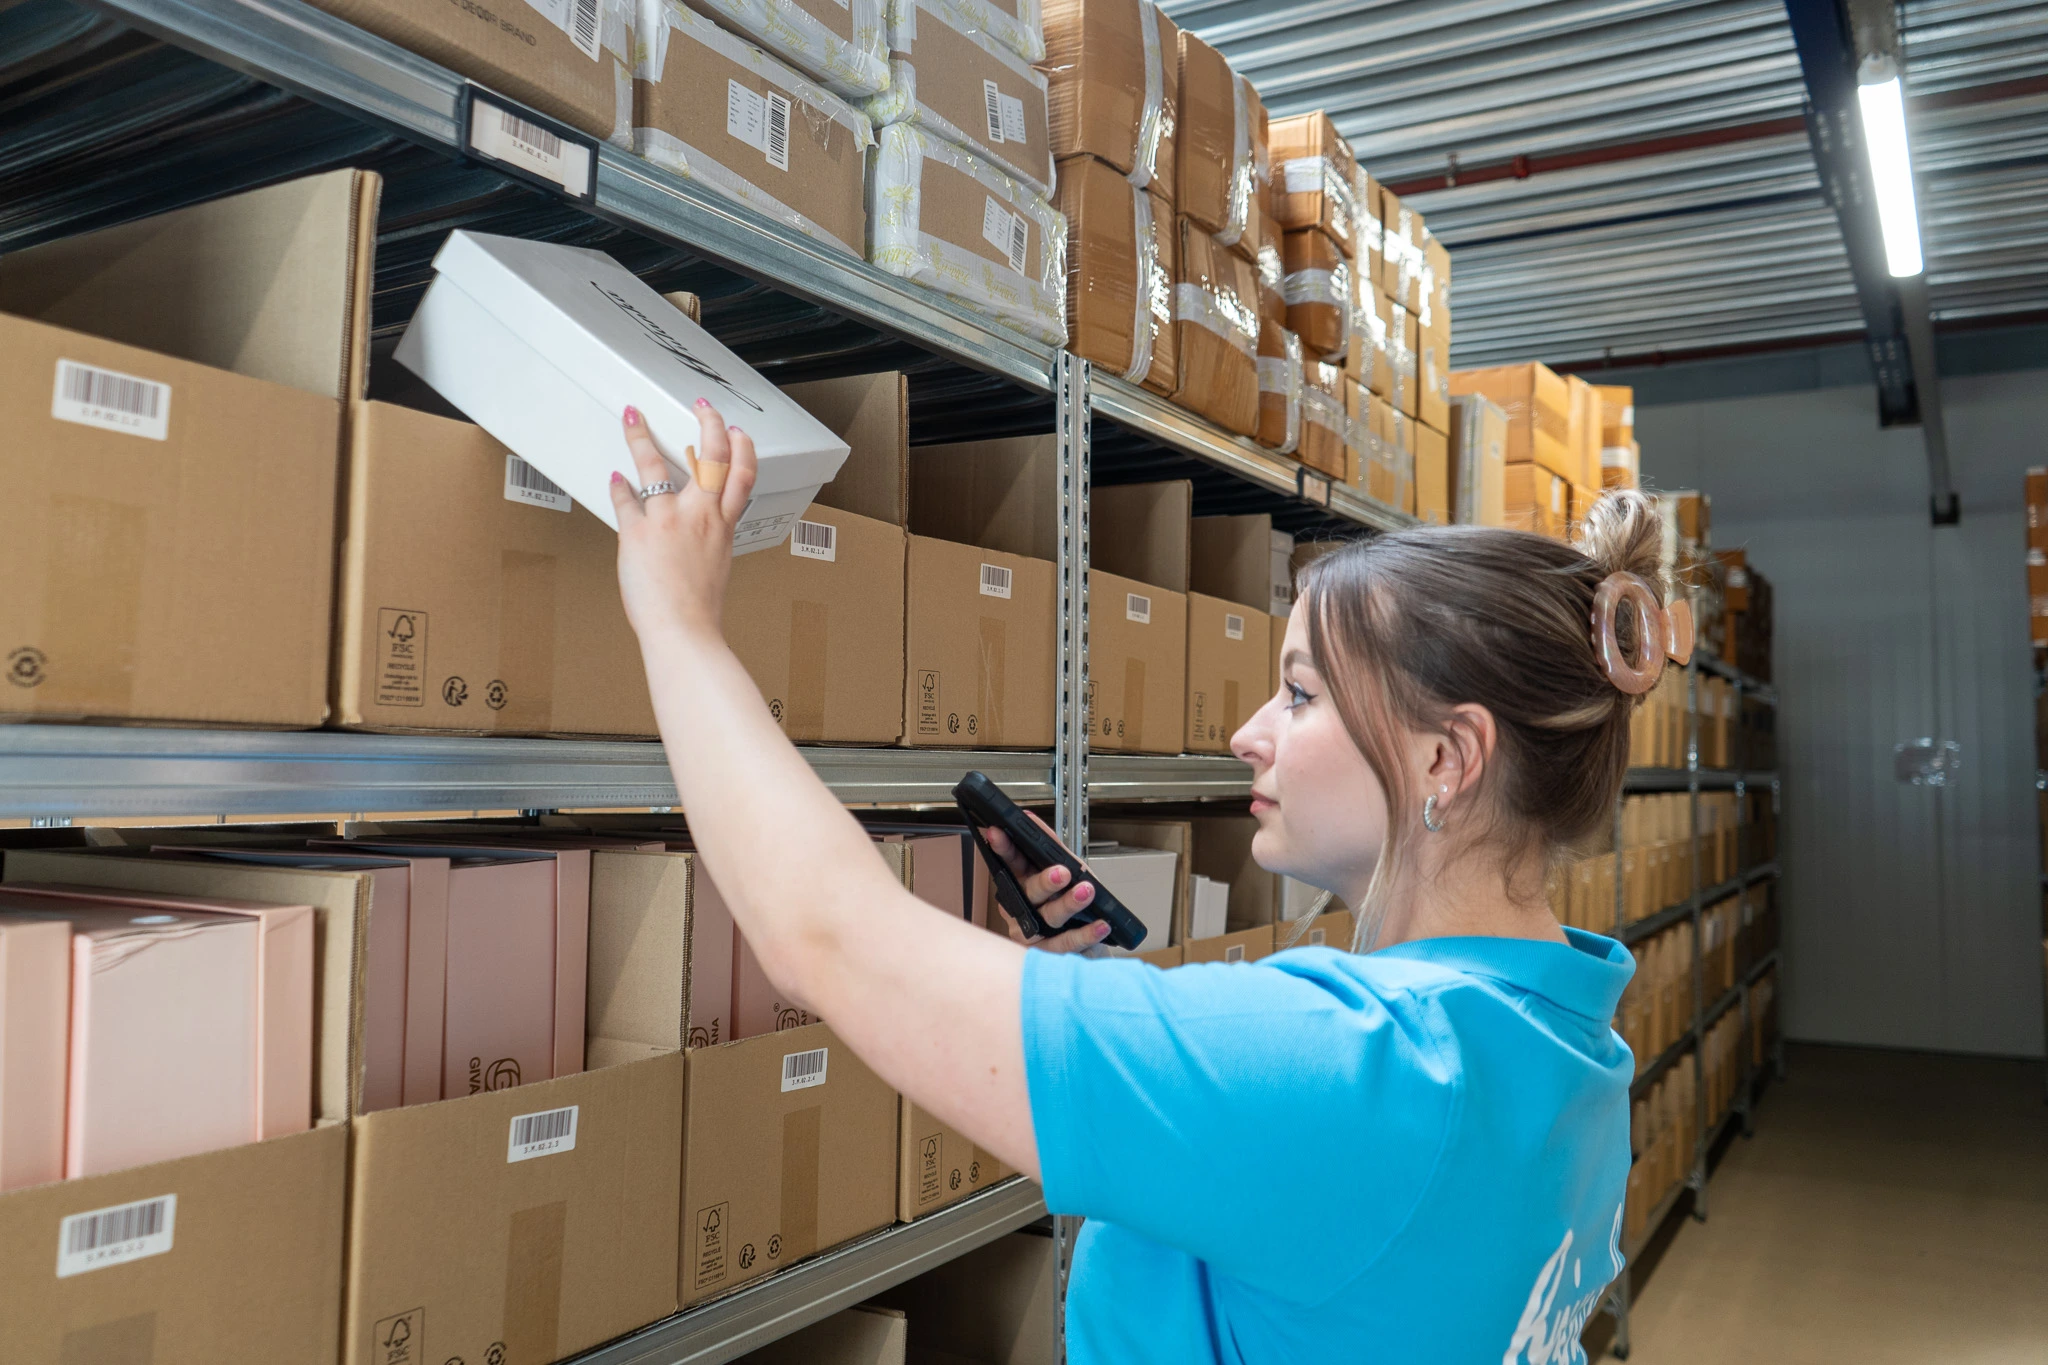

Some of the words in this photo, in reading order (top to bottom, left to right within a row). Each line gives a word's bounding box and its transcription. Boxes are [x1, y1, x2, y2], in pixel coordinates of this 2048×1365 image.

[499, 19, 537, 47] BRAND
[801, 545, 825, 555] 3.M.02.1.4
[392, 643, 415, 653] FSC
[469, 1056, 481, 1096] GIVA
[523, 1140, 559, 1154] 3.M.02.2.3
[705, 1231, 720, 1243] FSC
